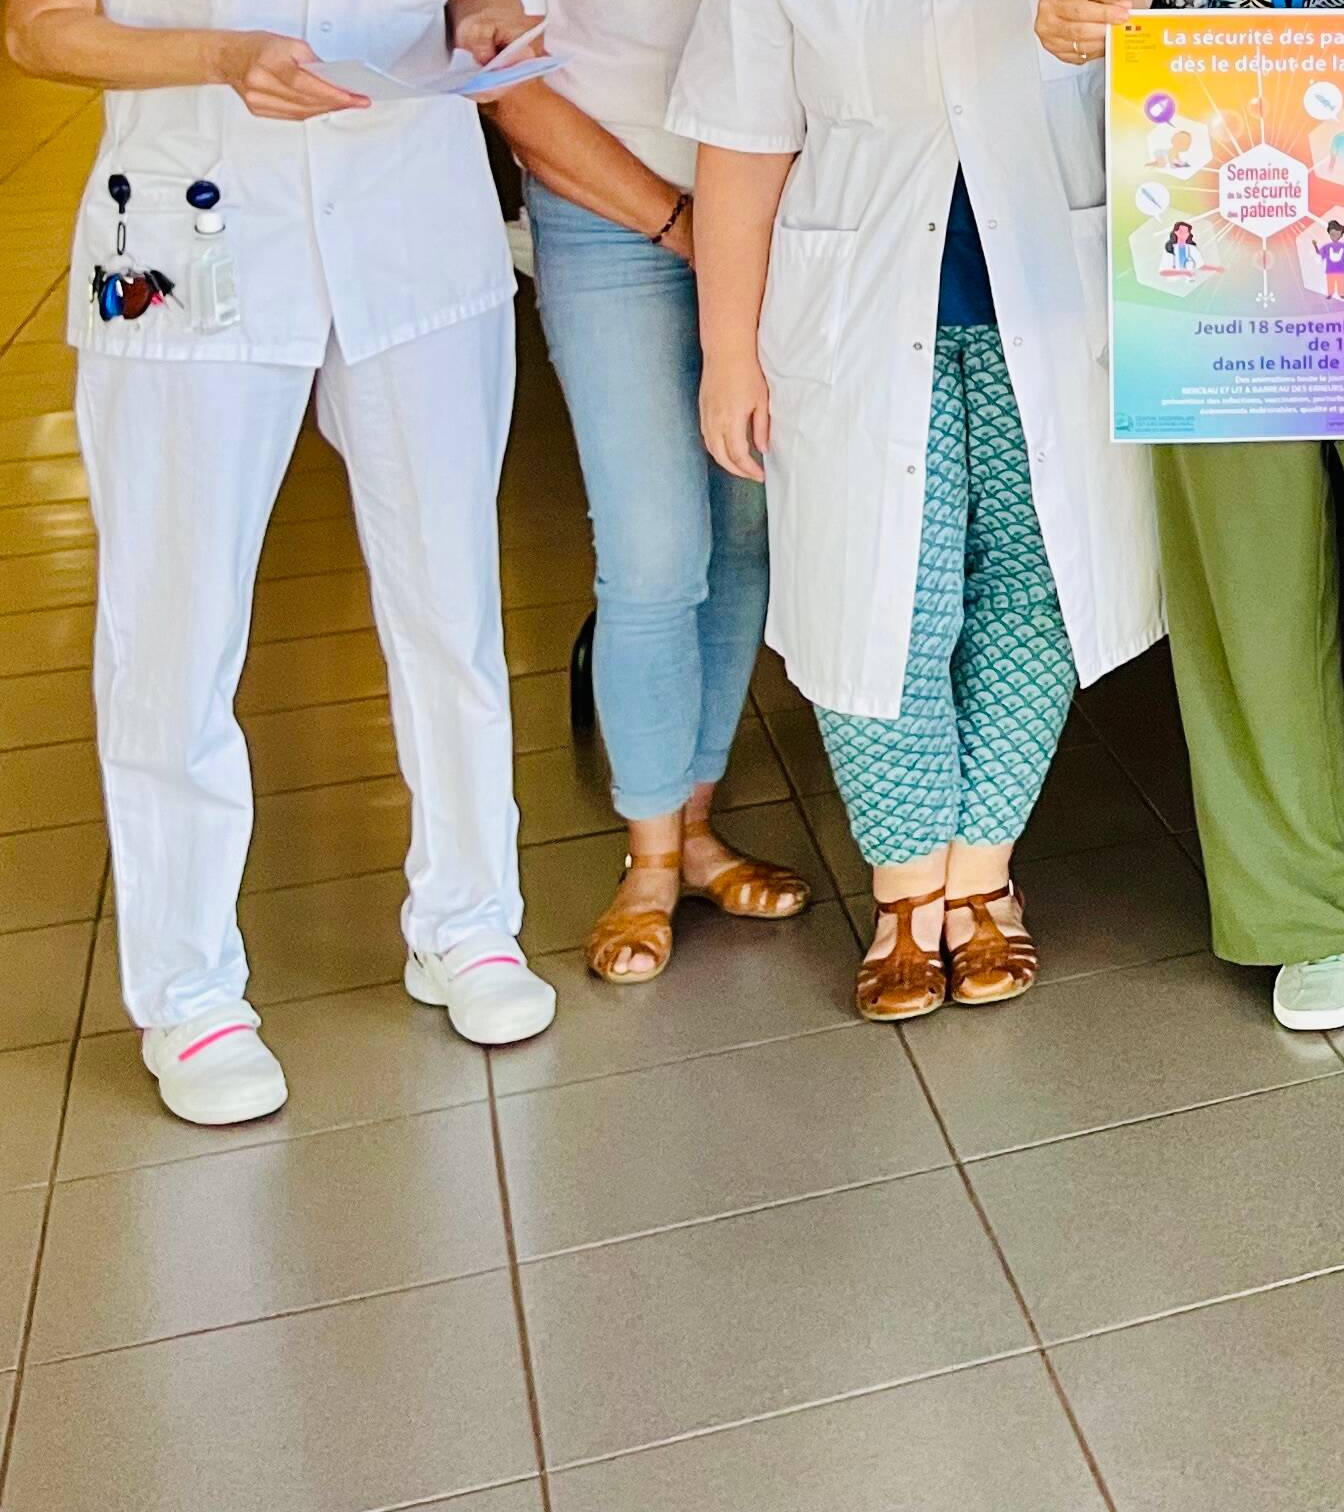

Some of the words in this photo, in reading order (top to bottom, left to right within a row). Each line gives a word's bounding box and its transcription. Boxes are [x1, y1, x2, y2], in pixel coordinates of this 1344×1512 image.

[1162, 29, 1187, 45] La
[1192, 28, 1274, 45] sécurité
[1279, 29, 1315, 45] des
[1170, 54, 1206, 72] dès
[1211, 55, 1229, 72] le
[1234, 55, 1298, 73] début
[1301, 54, 1328, 72] de
[1226, 163, 1289, 181] Semaine
[1243, 180, 1302, 199] sécurité
[1240, 200, 1297, 223] patients
[1195, 319, 1243, 336] Jeudi
[1249, 320, 1269, 334] 18
[1308, 338, 1330, 352] de
[1212, 356, 1256, 372] dans
[1260, 355, 1276, 371] le
[1280, 355, 1313, 370] hall
[1317, 354, 1340, 370] de
